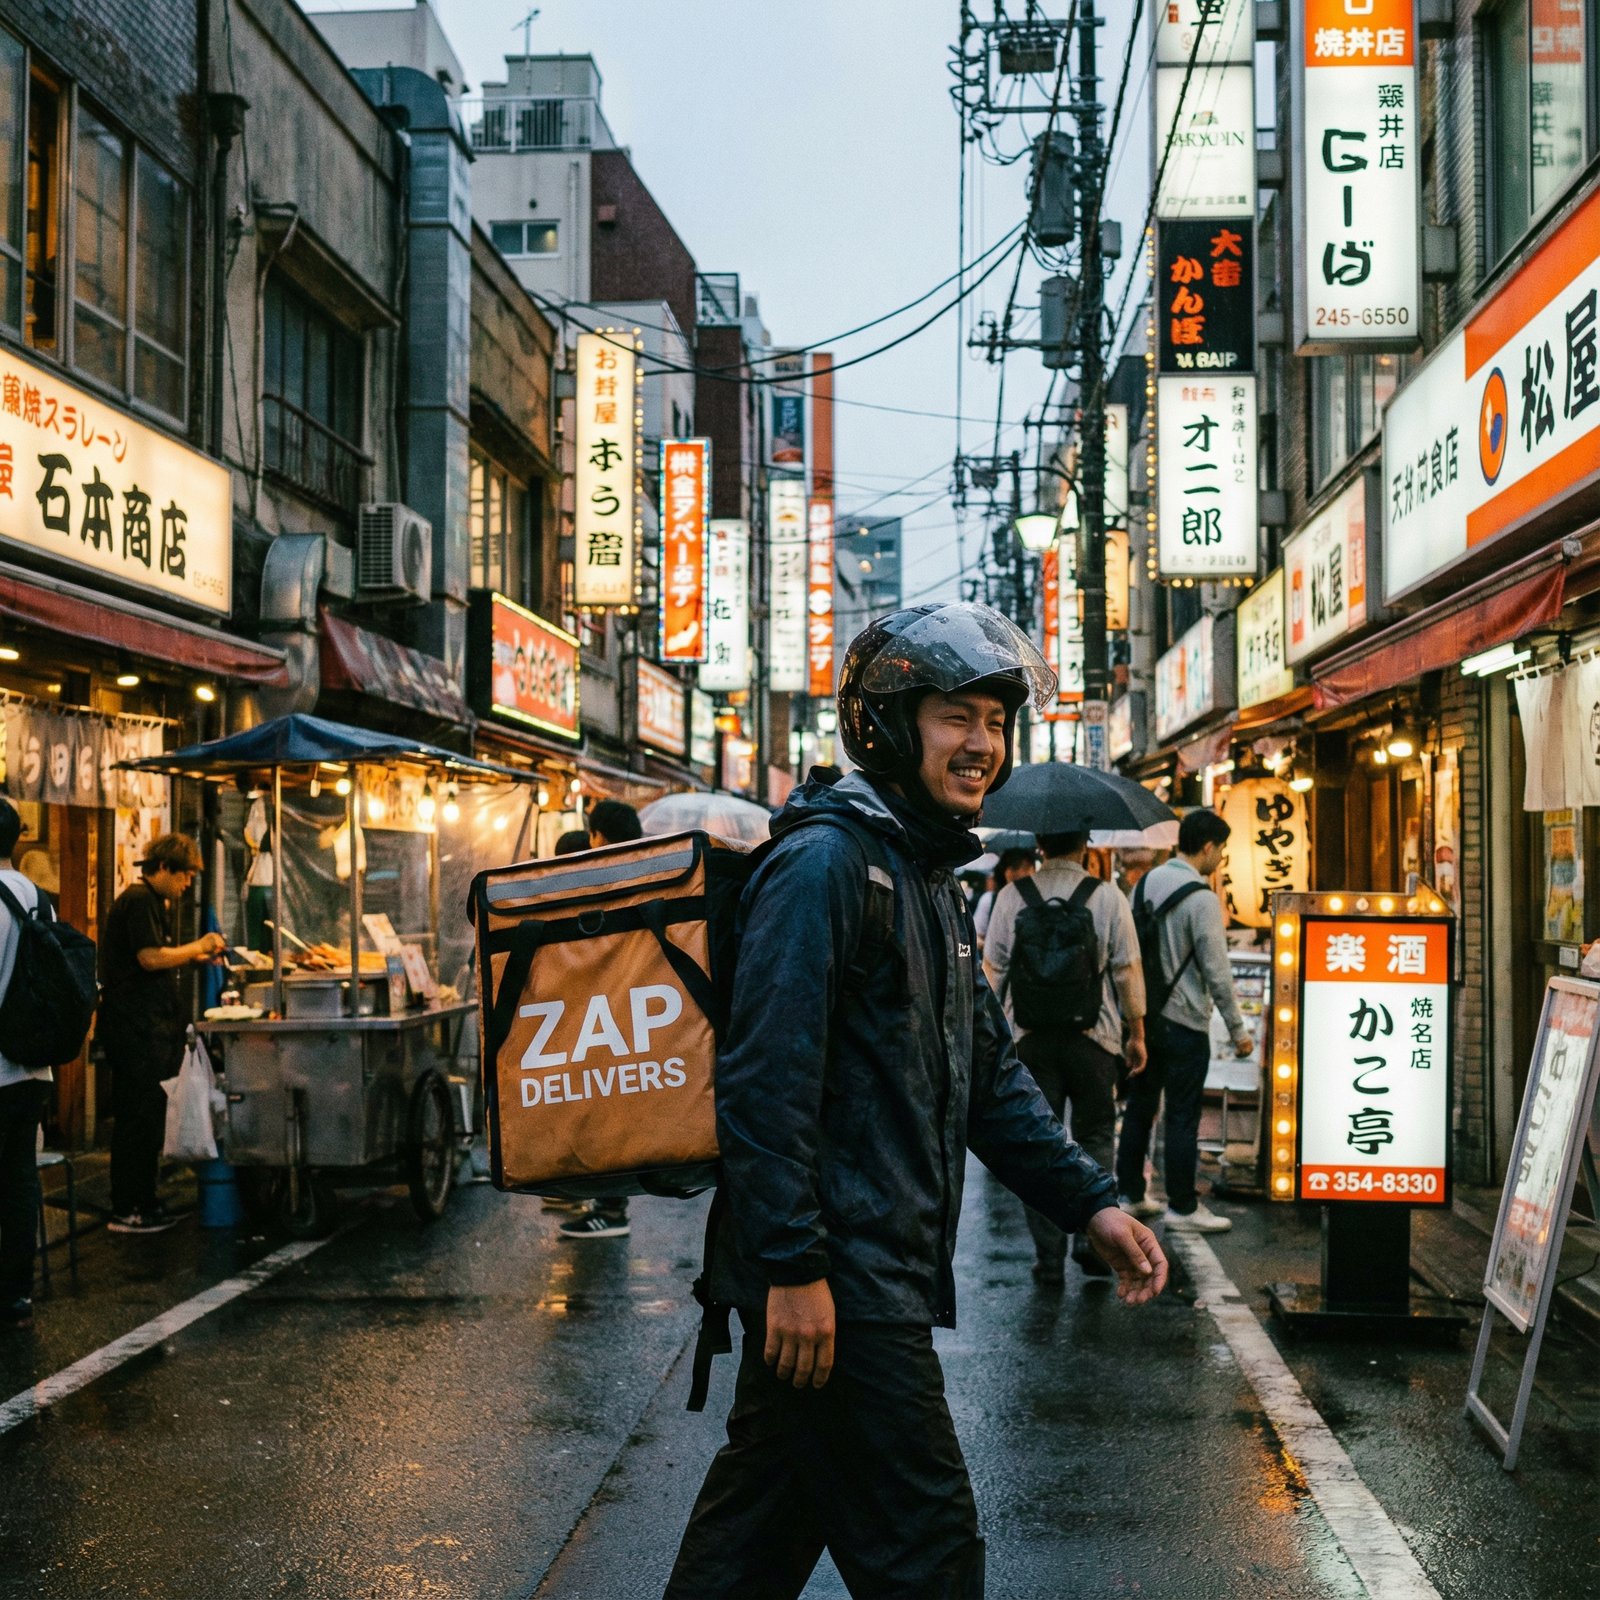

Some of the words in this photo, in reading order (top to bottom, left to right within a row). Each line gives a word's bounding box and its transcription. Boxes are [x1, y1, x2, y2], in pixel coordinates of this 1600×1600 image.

[1315, 306, 1410, 327] 245-6550
[1520, 288, 1600, 453] 松屋
[35, 453, 188, 581] 石本商店
[518, 983, 683, 1071] ZAP
[520, 1056, 688, 1108] DELIVERS
[1347, 996, 1394, 1156] かこ亭
[1333, 1170, 1438, 1196] 354-8330
